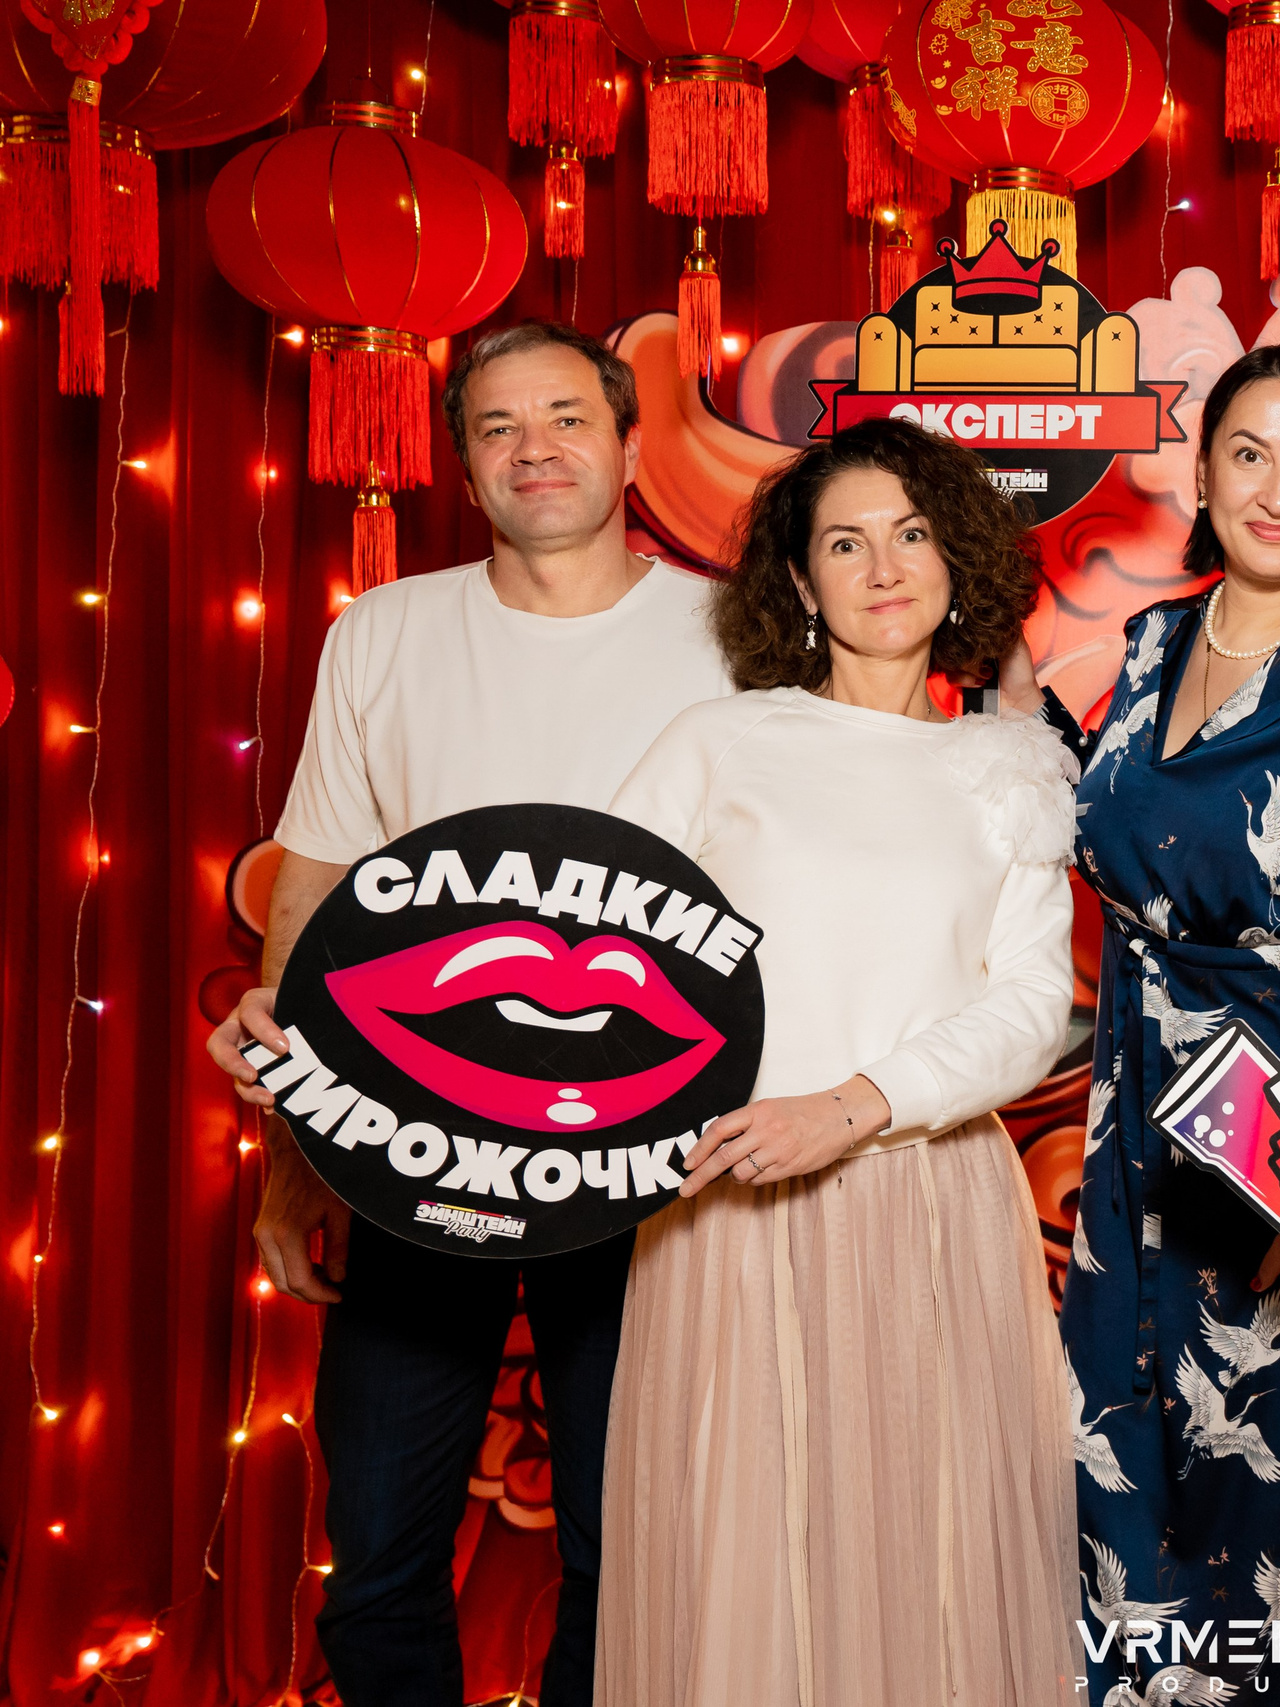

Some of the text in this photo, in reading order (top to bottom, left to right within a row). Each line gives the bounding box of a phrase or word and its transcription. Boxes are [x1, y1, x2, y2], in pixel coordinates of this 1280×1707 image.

[353, 850, 759, 977] СЛАДКИЕ
[243, 1024, 719, 1203] ПИРОЖОЧК
[416, 1203, 527, 1236] ЭЙНШТЕЙН
[444, 1220, 491, 1243] Party
